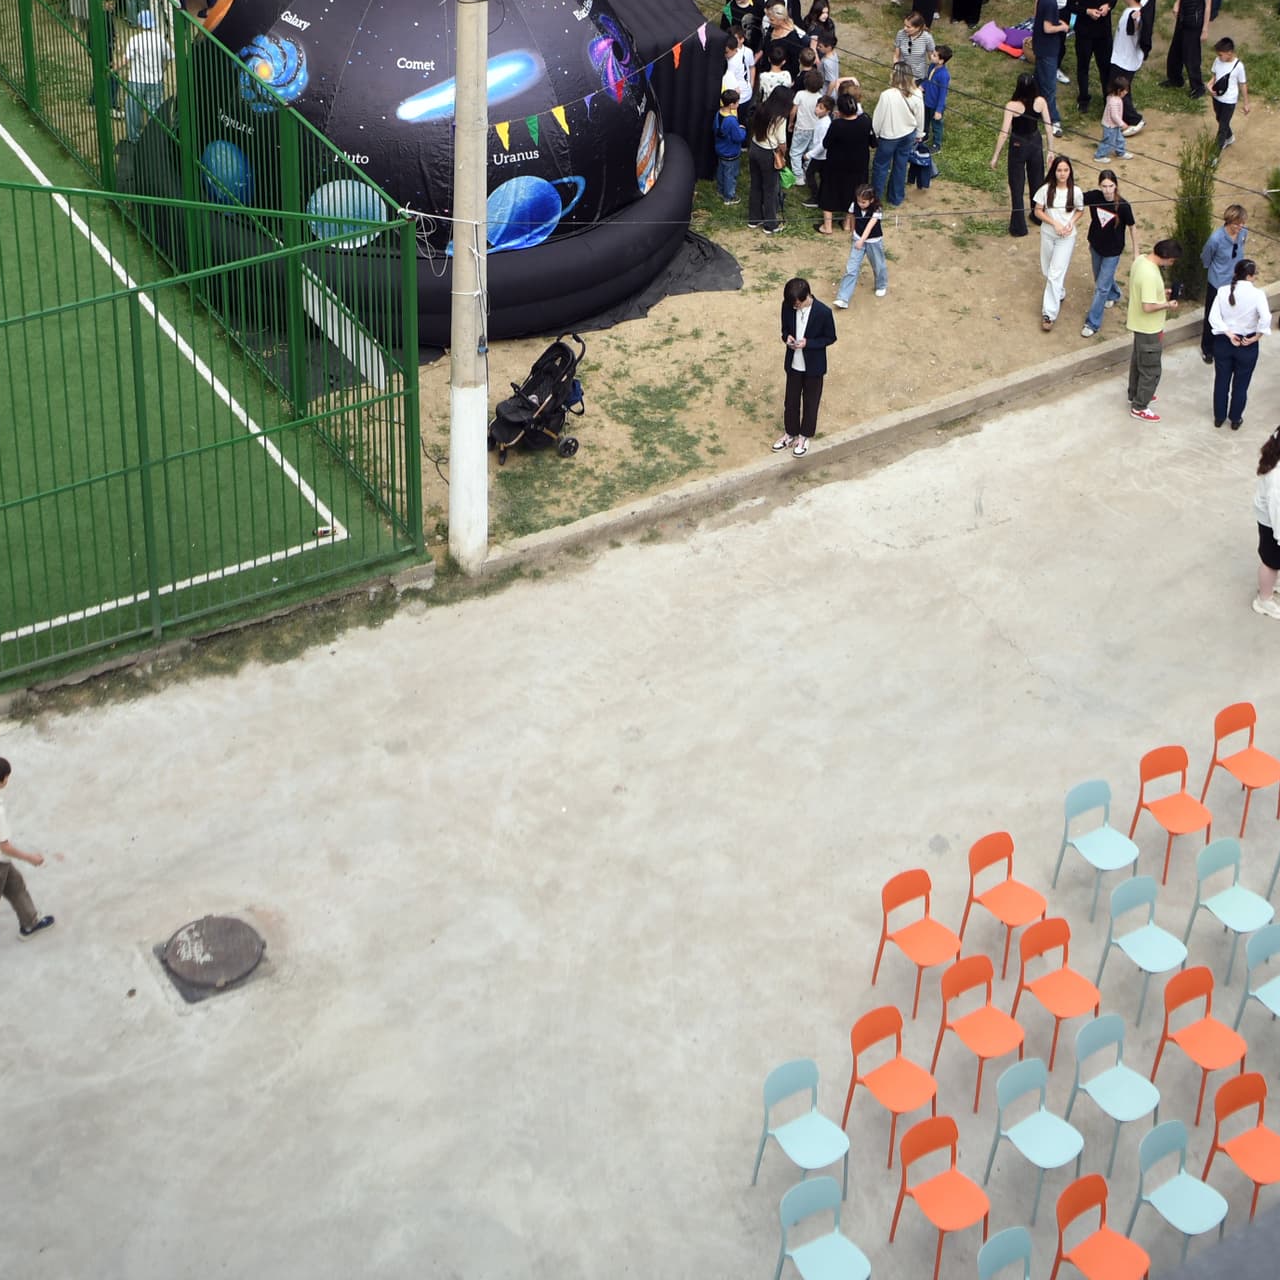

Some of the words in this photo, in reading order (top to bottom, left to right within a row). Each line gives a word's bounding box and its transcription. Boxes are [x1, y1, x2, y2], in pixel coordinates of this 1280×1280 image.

[280, 10, 310, 31] Galaxy
[396, 57, 436, 71] Comet
[493, 149, 540, 165] Uranus
